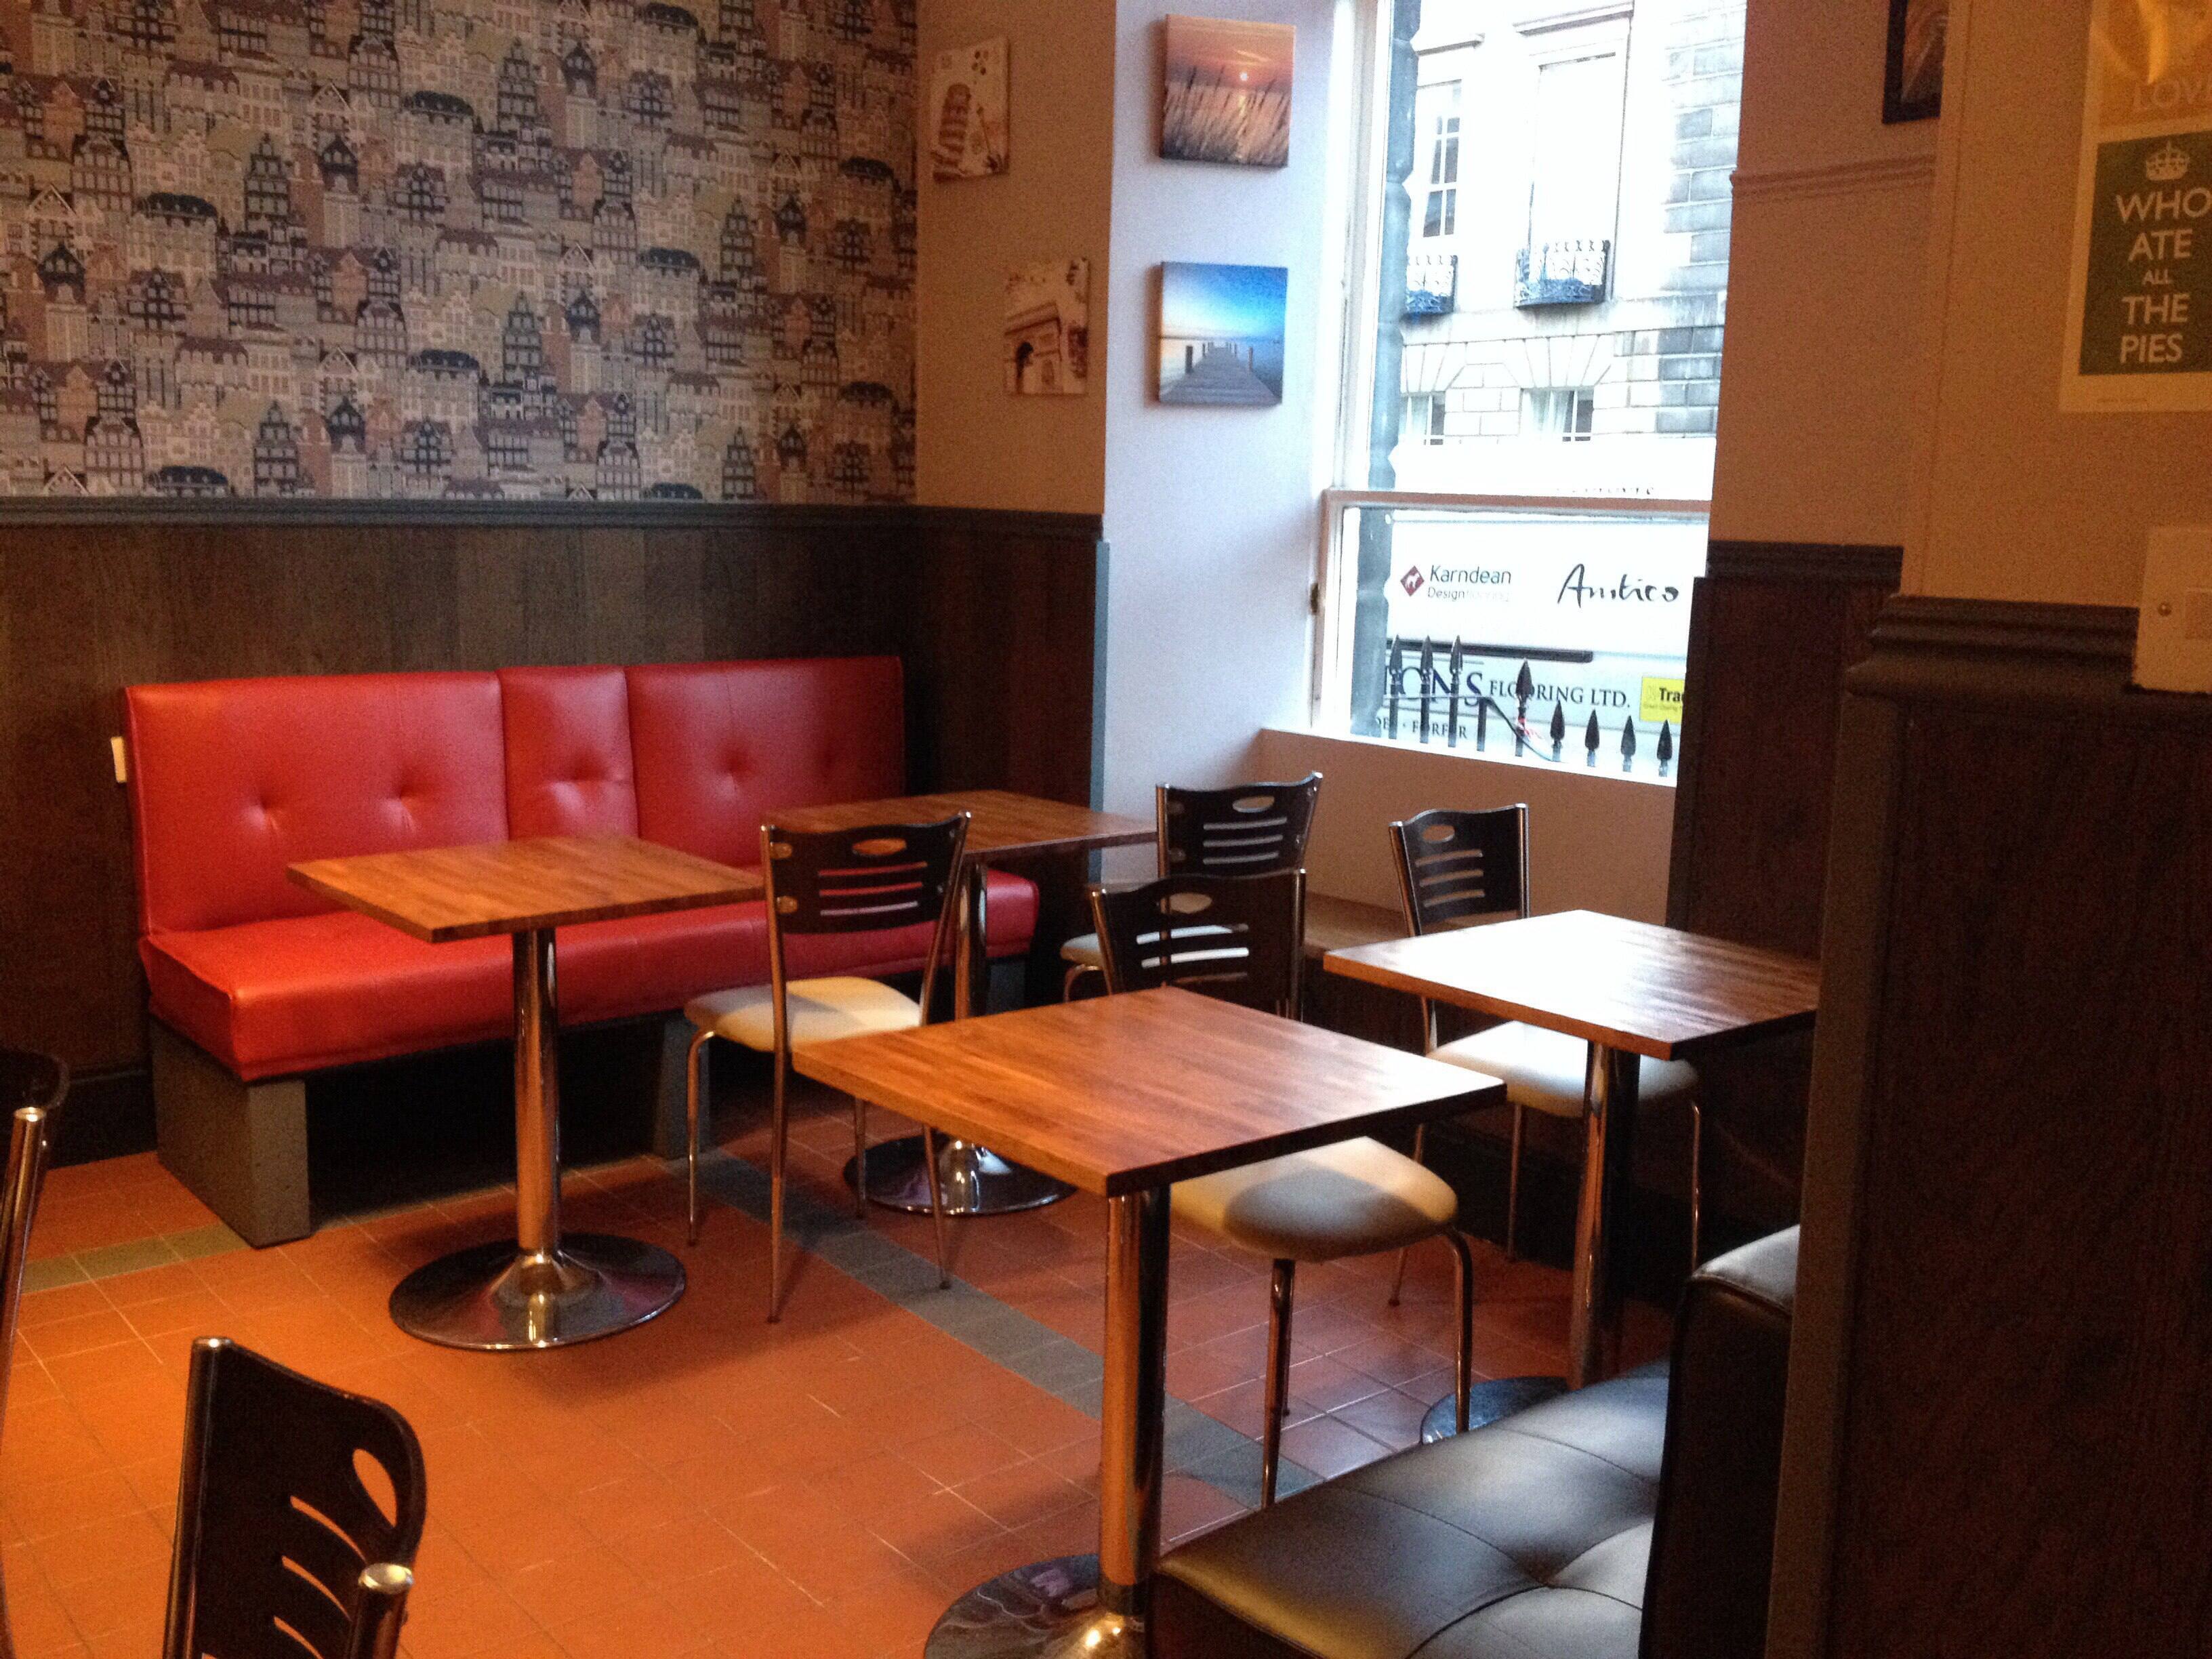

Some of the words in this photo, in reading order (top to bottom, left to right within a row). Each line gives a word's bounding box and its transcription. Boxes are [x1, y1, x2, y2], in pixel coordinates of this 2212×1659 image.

[2131, 73, 2212, 112] LOV
[2115, 186, 2212, 224] WHO
[2127, 228, 2194, 262] ATE
[2141, 268, 2173, 286] ALL
[2121, 292, 2192, 326] THE
[2119, 333, 2184, 364] PIES
[1429, 564, 1512, 584] Karndean
[1590, 687, 1631, 708] LTD.
[1658, 687, 1683, 702] Tra
[1413, 720, 1467, 739] FRFR
